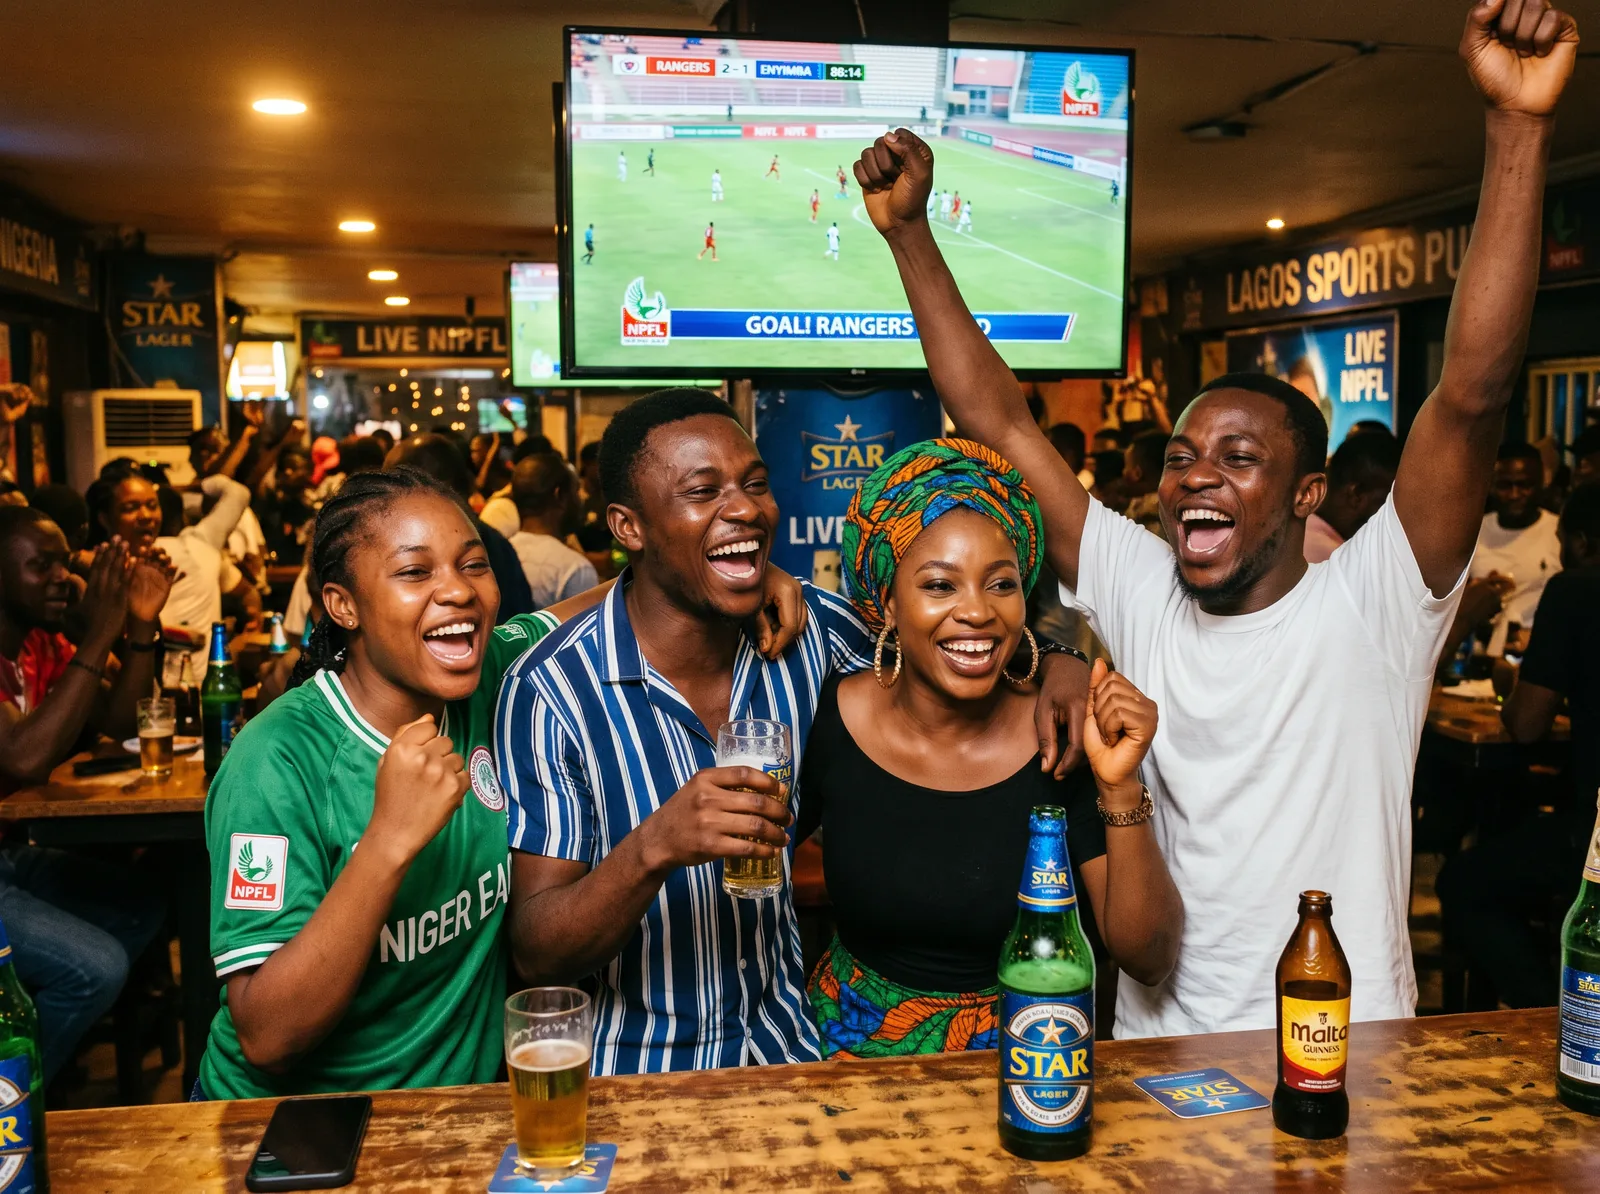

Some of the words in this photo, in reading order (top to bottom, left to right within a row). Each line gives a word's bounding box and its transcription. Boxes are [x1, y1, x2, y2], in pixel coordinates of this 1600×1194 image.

[656, 60, 710, 73] RANGERS
[722, 63, 730, 73] 2
[1065, 103, 1097, 115] NPFL
[1227, 258, 1302, 314] LAGOS
[1306, 233, 1416, 304] SPORTS
[1425, 224, 1476, 284] PU
[122, 301, 204, 328] STAR
[627, 323, 665, 336] NPFL
[745, 315, 811, 335] GOAL!
[816, 316, 914, 336] RANGERS
[136, 333, 193, 347] LAGER
[357, 326, 420, 352] LIVE
[1345, 328, 1387, 366] LIVE
[1341, 368, 1389, 403] NPFL
[811, 444, 884, 470] STAR
[823, 477, 863, 490] LAGE
[1031, 871, 1068, 886] STAR
[234, 885, 272, 899] NPFL
[380, 890, 472, 963] NIGER
[1291, 1022, 1348, 1043] Malta
[1303, 1044, 1340, 1054] GUINNESS
[1010, 1047, 1089, 1078] STAR
[1033, 1090, 1069, 1099] LAGER
[1161, 1082, 1240, 1101] STAR
